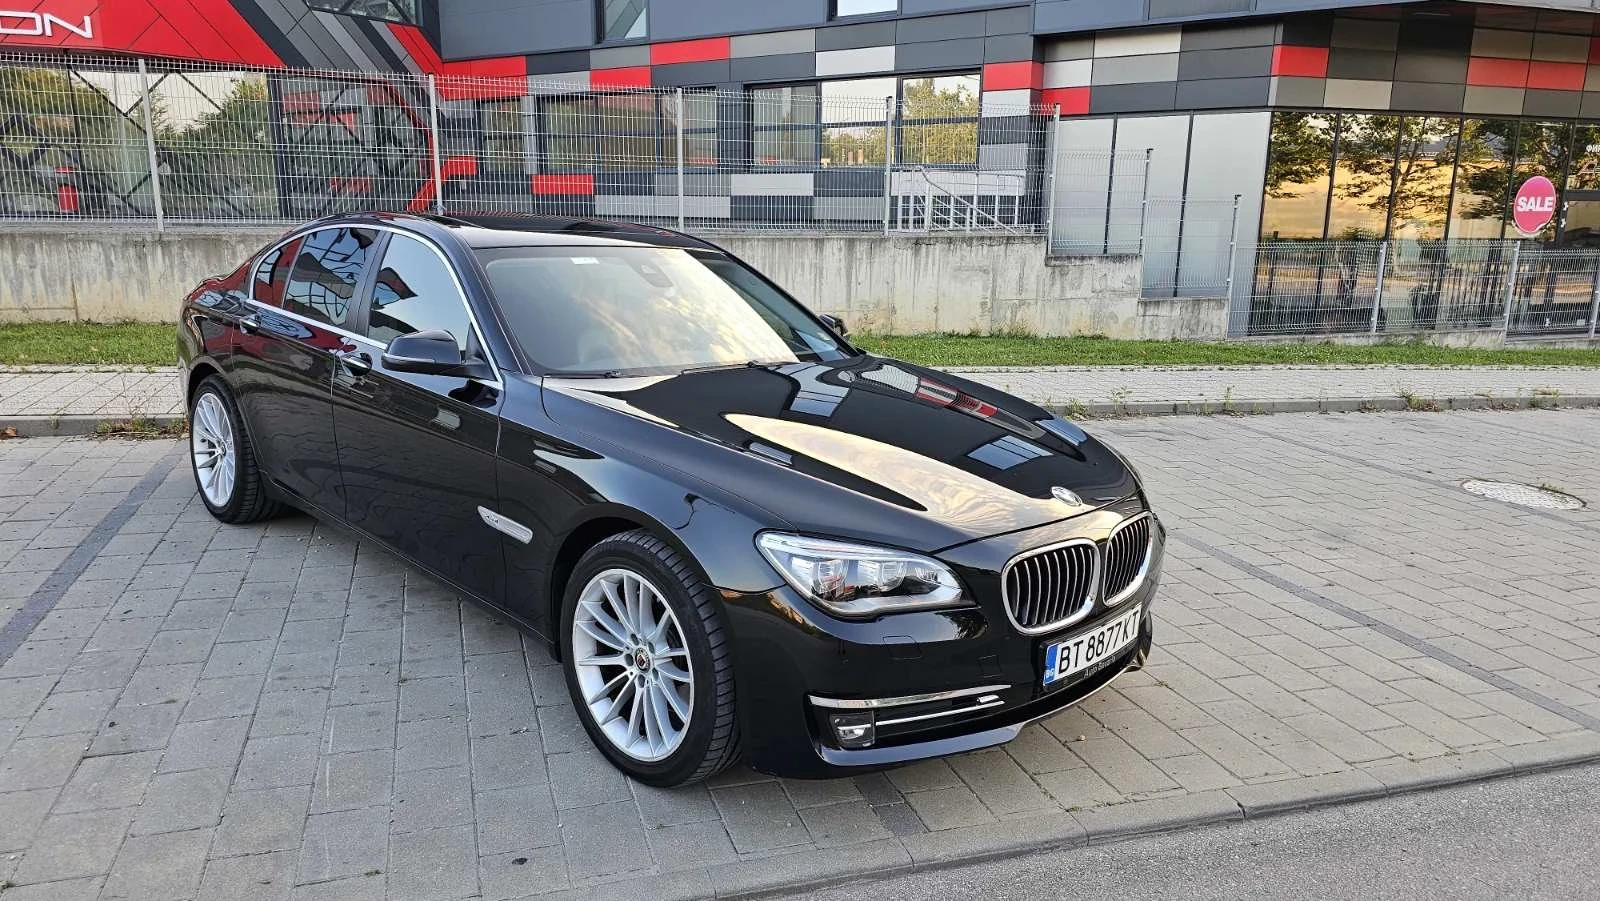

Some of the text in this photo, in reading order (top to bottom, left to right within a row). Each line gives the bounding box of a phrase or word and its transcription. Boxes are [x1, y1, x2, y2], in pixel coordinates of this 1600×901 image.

[1517, 196, 1554, 212] SALE
[1059, 640, 1083, 674] BT
[1045, 668, 1056, 679] BG
